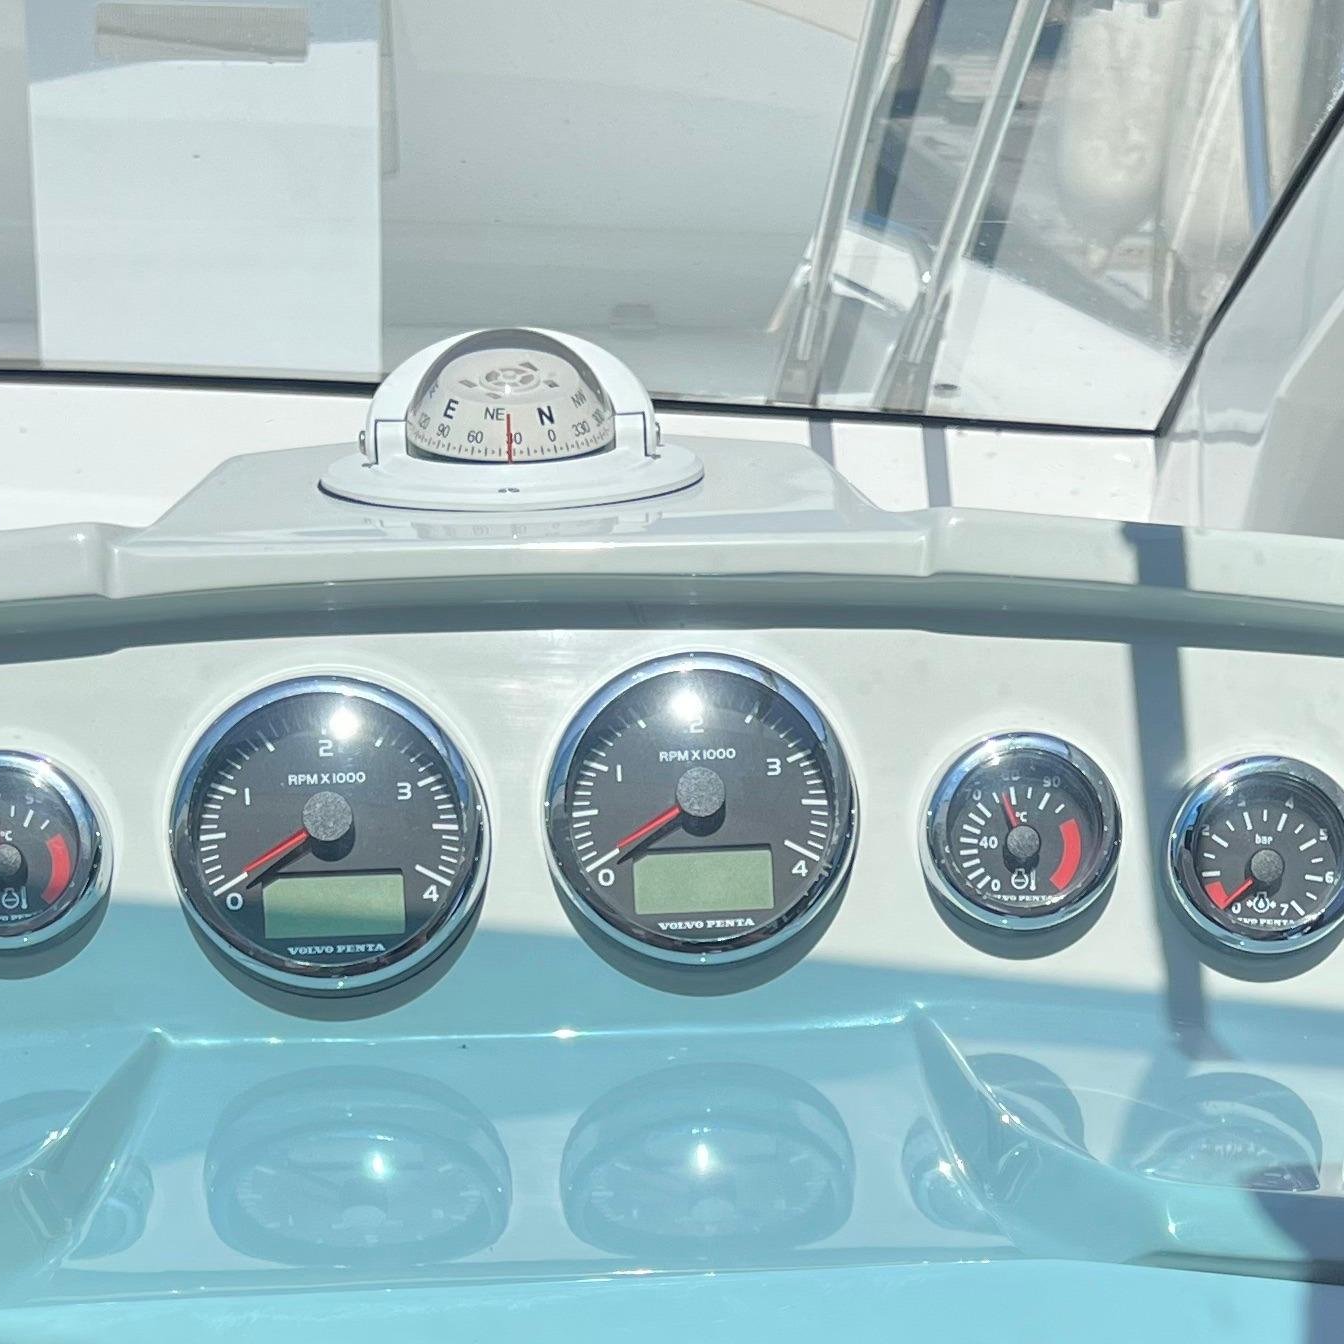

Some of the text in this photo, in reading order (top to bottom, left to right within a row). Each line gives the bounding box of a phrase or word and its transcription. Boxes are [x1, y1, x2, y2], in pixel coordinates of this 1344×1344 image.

[443, 399, 459, 420] E
[483, 407, 506, 421] NE
[538, 406, 555, 425] N
[435, 423, 450, 438] 90
[547, 429, 557, 443] 0
[571, 420, 591, 438] 330
[467, 429, 484, 444] 60
[689, 719, 704, 733] 2
[318, 740, 334, 757] 2
[659, 750, 689, 762] RPM
[691, 750, 700, 760] X
[766, 759, 781, 775] 3
[288, 774, 319, 786] RPM
[321, 774, 330, 785] X
[397, 782, 412, 800] 3
[1015, 811, 1027, 822] °C
[0, 830, 13, 841] °C
[1255, 834, 1273, 845] bar
[1319, 829, 1328, 841] 5
[979, 836, 998, 849] 40
[792, 860, 808, 877] 4
[598, 869, 615, 886] 0
[1325, 872, 1334, 883] 6
[991, 880, 1000, 891] 0
[422, 885, 439, 902] 4
[226, 893, 243, 910] 0
[1232, 903, 1241, 914] 0
[1280, 904, 1289, 916] 7
[658, 918, 755, 931] VOLVO PENTA
[288, 943, 385, 955] VOLVO PENTA
